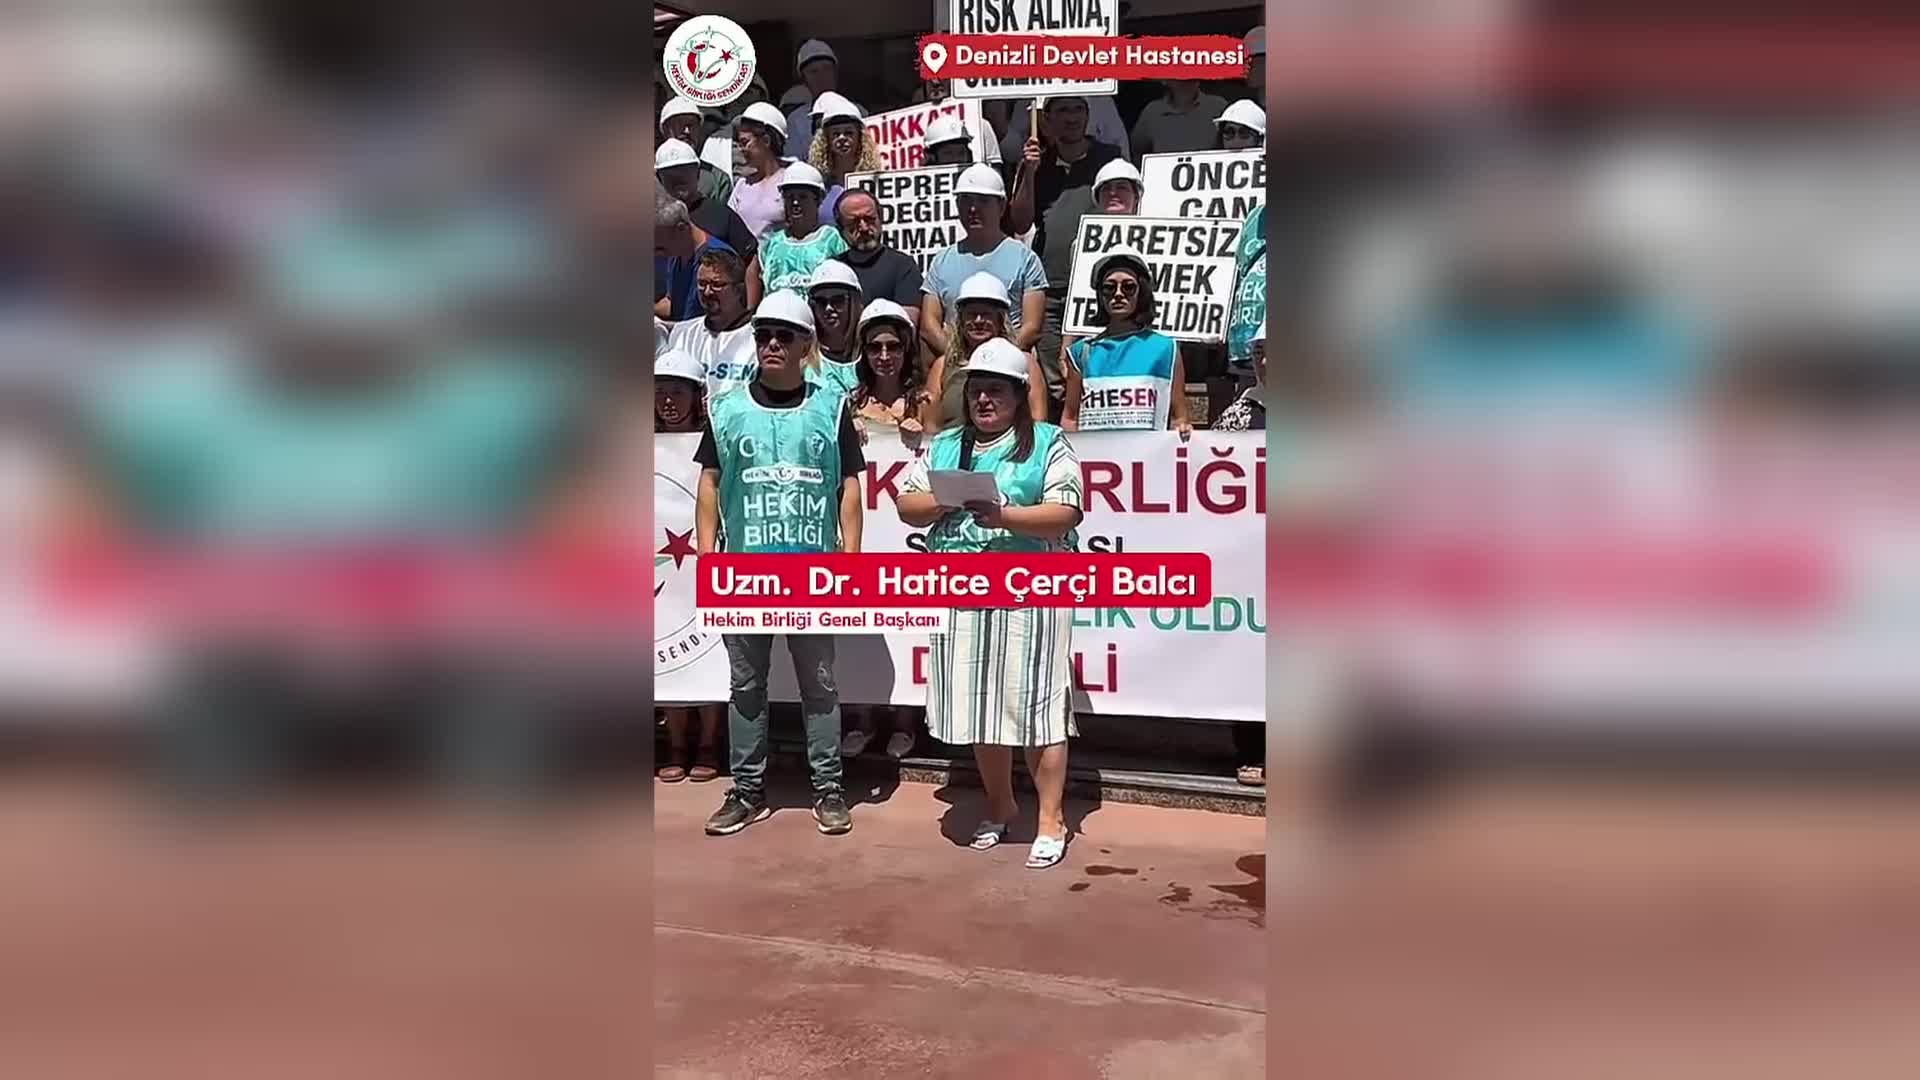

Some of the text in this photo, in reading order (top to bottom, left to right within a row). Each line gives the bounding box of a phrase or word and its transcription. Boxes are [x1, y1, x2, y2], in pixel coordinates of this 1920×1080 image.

[1082, 219, 1240, 258] BARETSİZ
[743, 488, 827, 519] HEKİM
[744, 520, 823, 546] BİRLİĞİ
